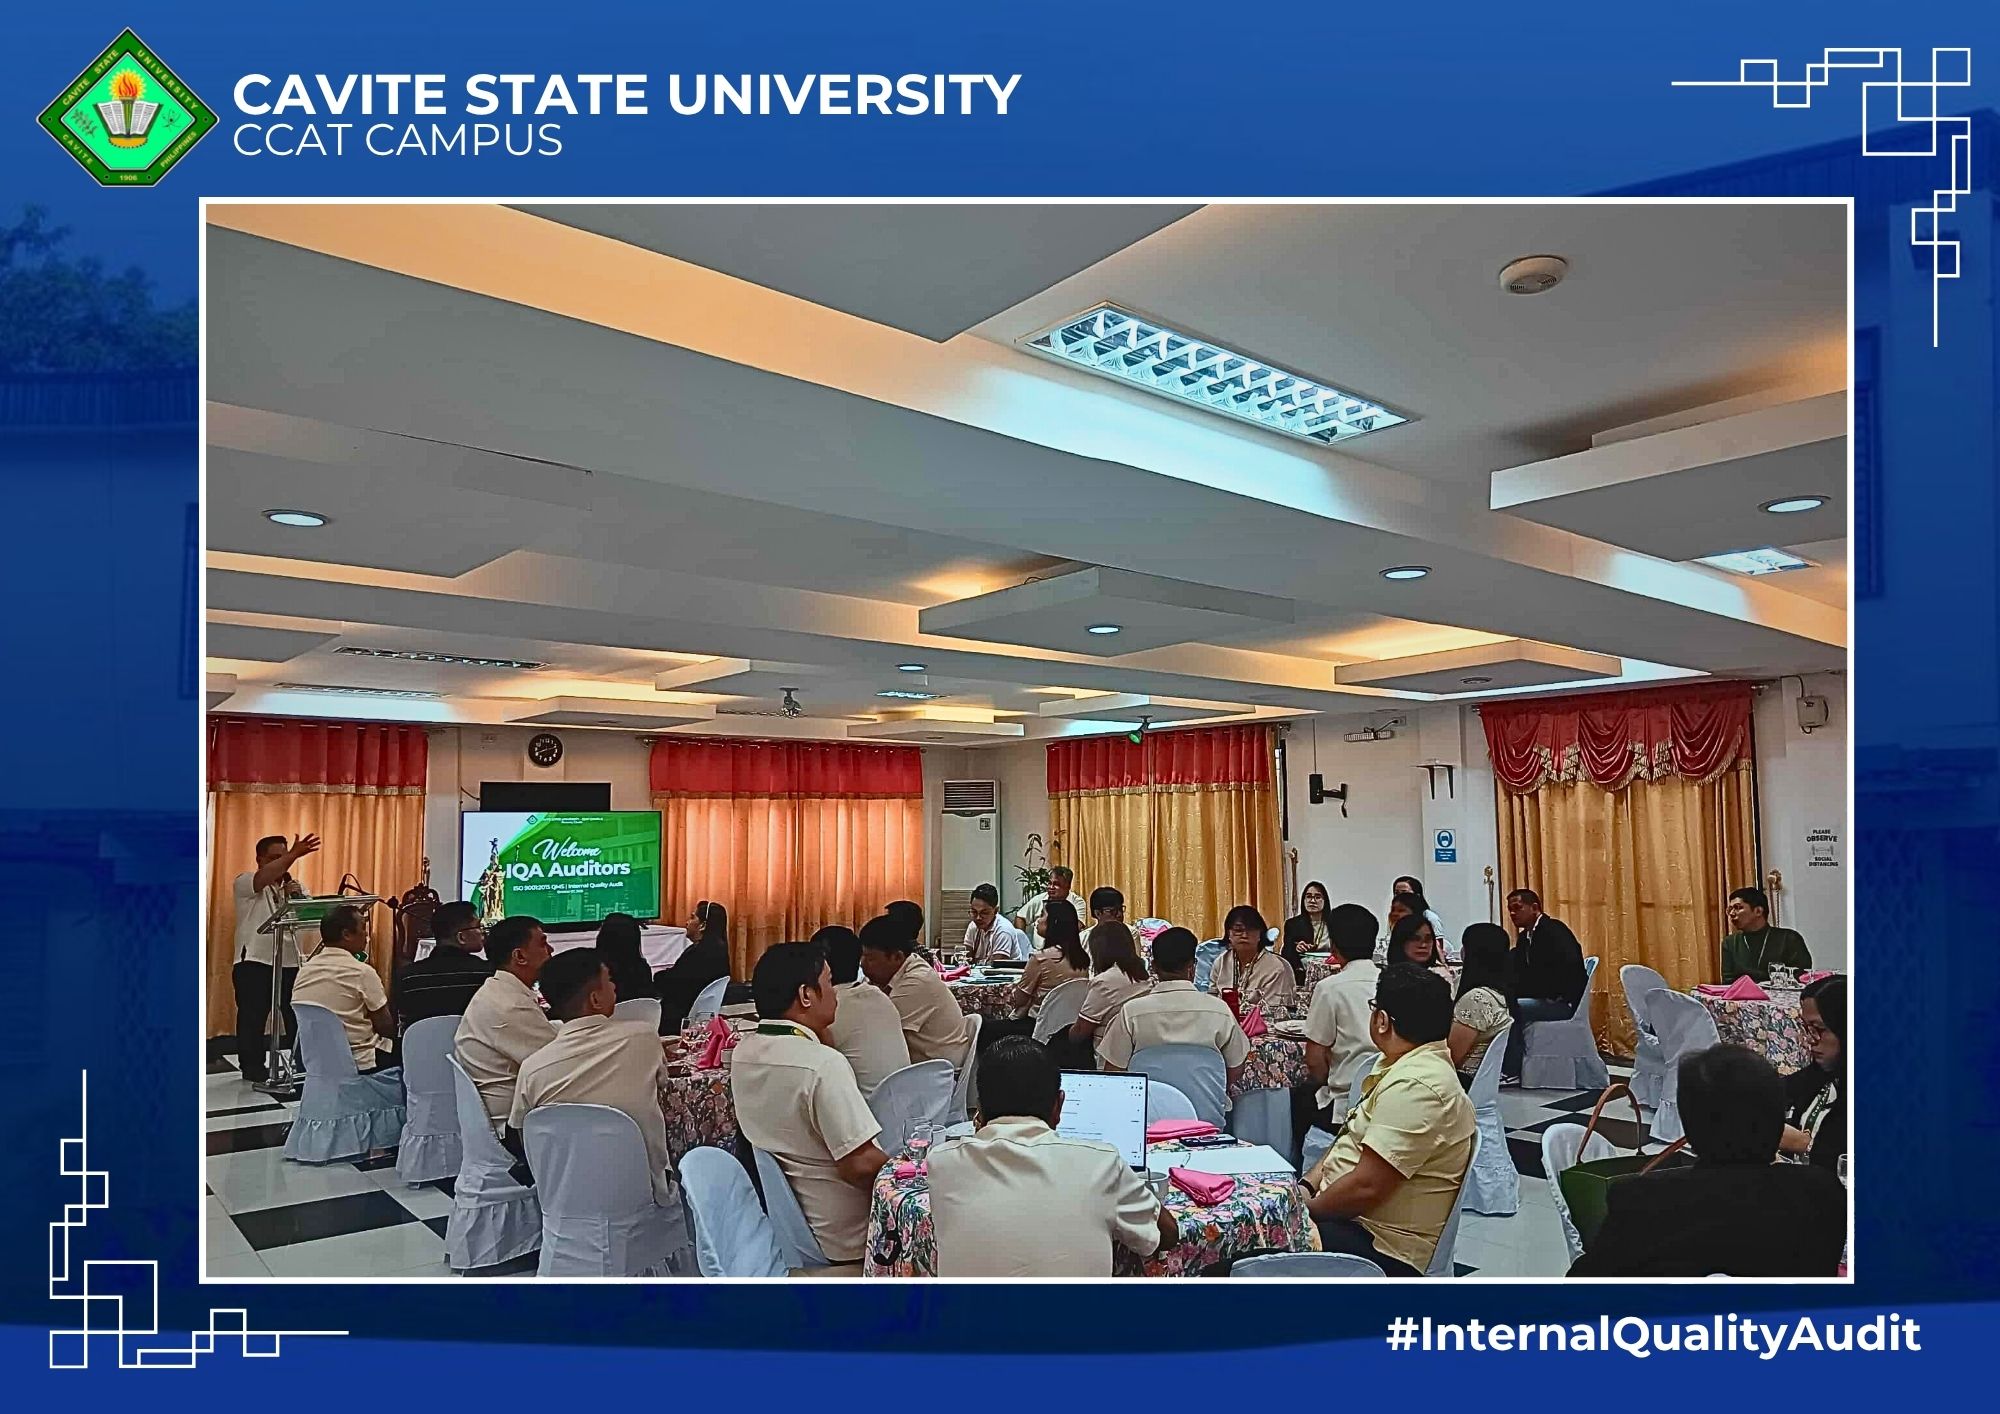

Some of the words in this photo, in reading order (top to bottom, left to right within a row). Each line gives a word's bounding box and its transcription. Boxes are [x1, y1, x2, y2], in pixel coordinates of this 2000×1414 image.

[533, 836, 602, 860] Welcome
[506, 863, 544, 881] IQA
[547, 860, 631, 877] Auditors
